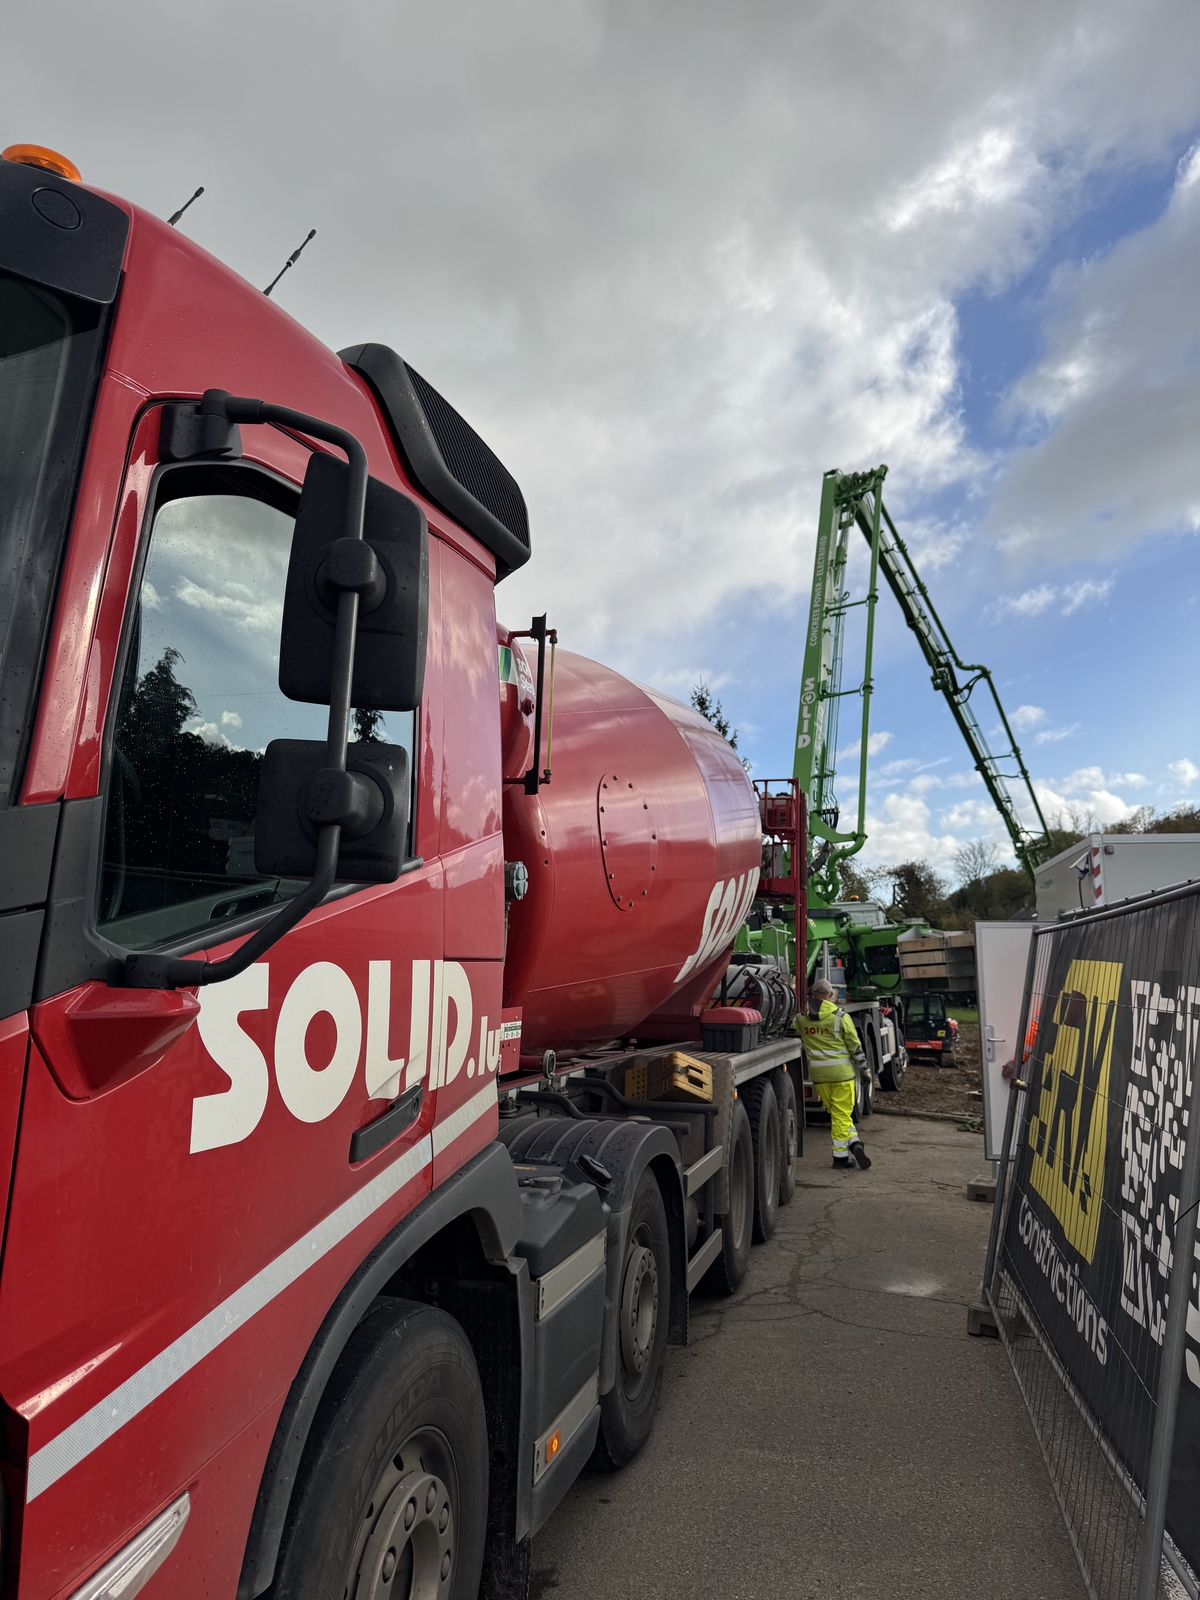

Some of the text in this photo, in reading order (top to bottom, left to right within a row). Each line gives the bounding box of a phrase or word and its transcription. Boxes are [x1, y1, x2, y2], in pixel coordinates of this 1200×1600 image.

[817, 535, 827, 577] ELECTRIFIED
[814, 582, 823, 608] POWER
[810, 608, 820, 647] CONCRETE
[190, 959, 501, 1154] SOLID.lu
[1018, 1194, 1108, 1365] Constructions
